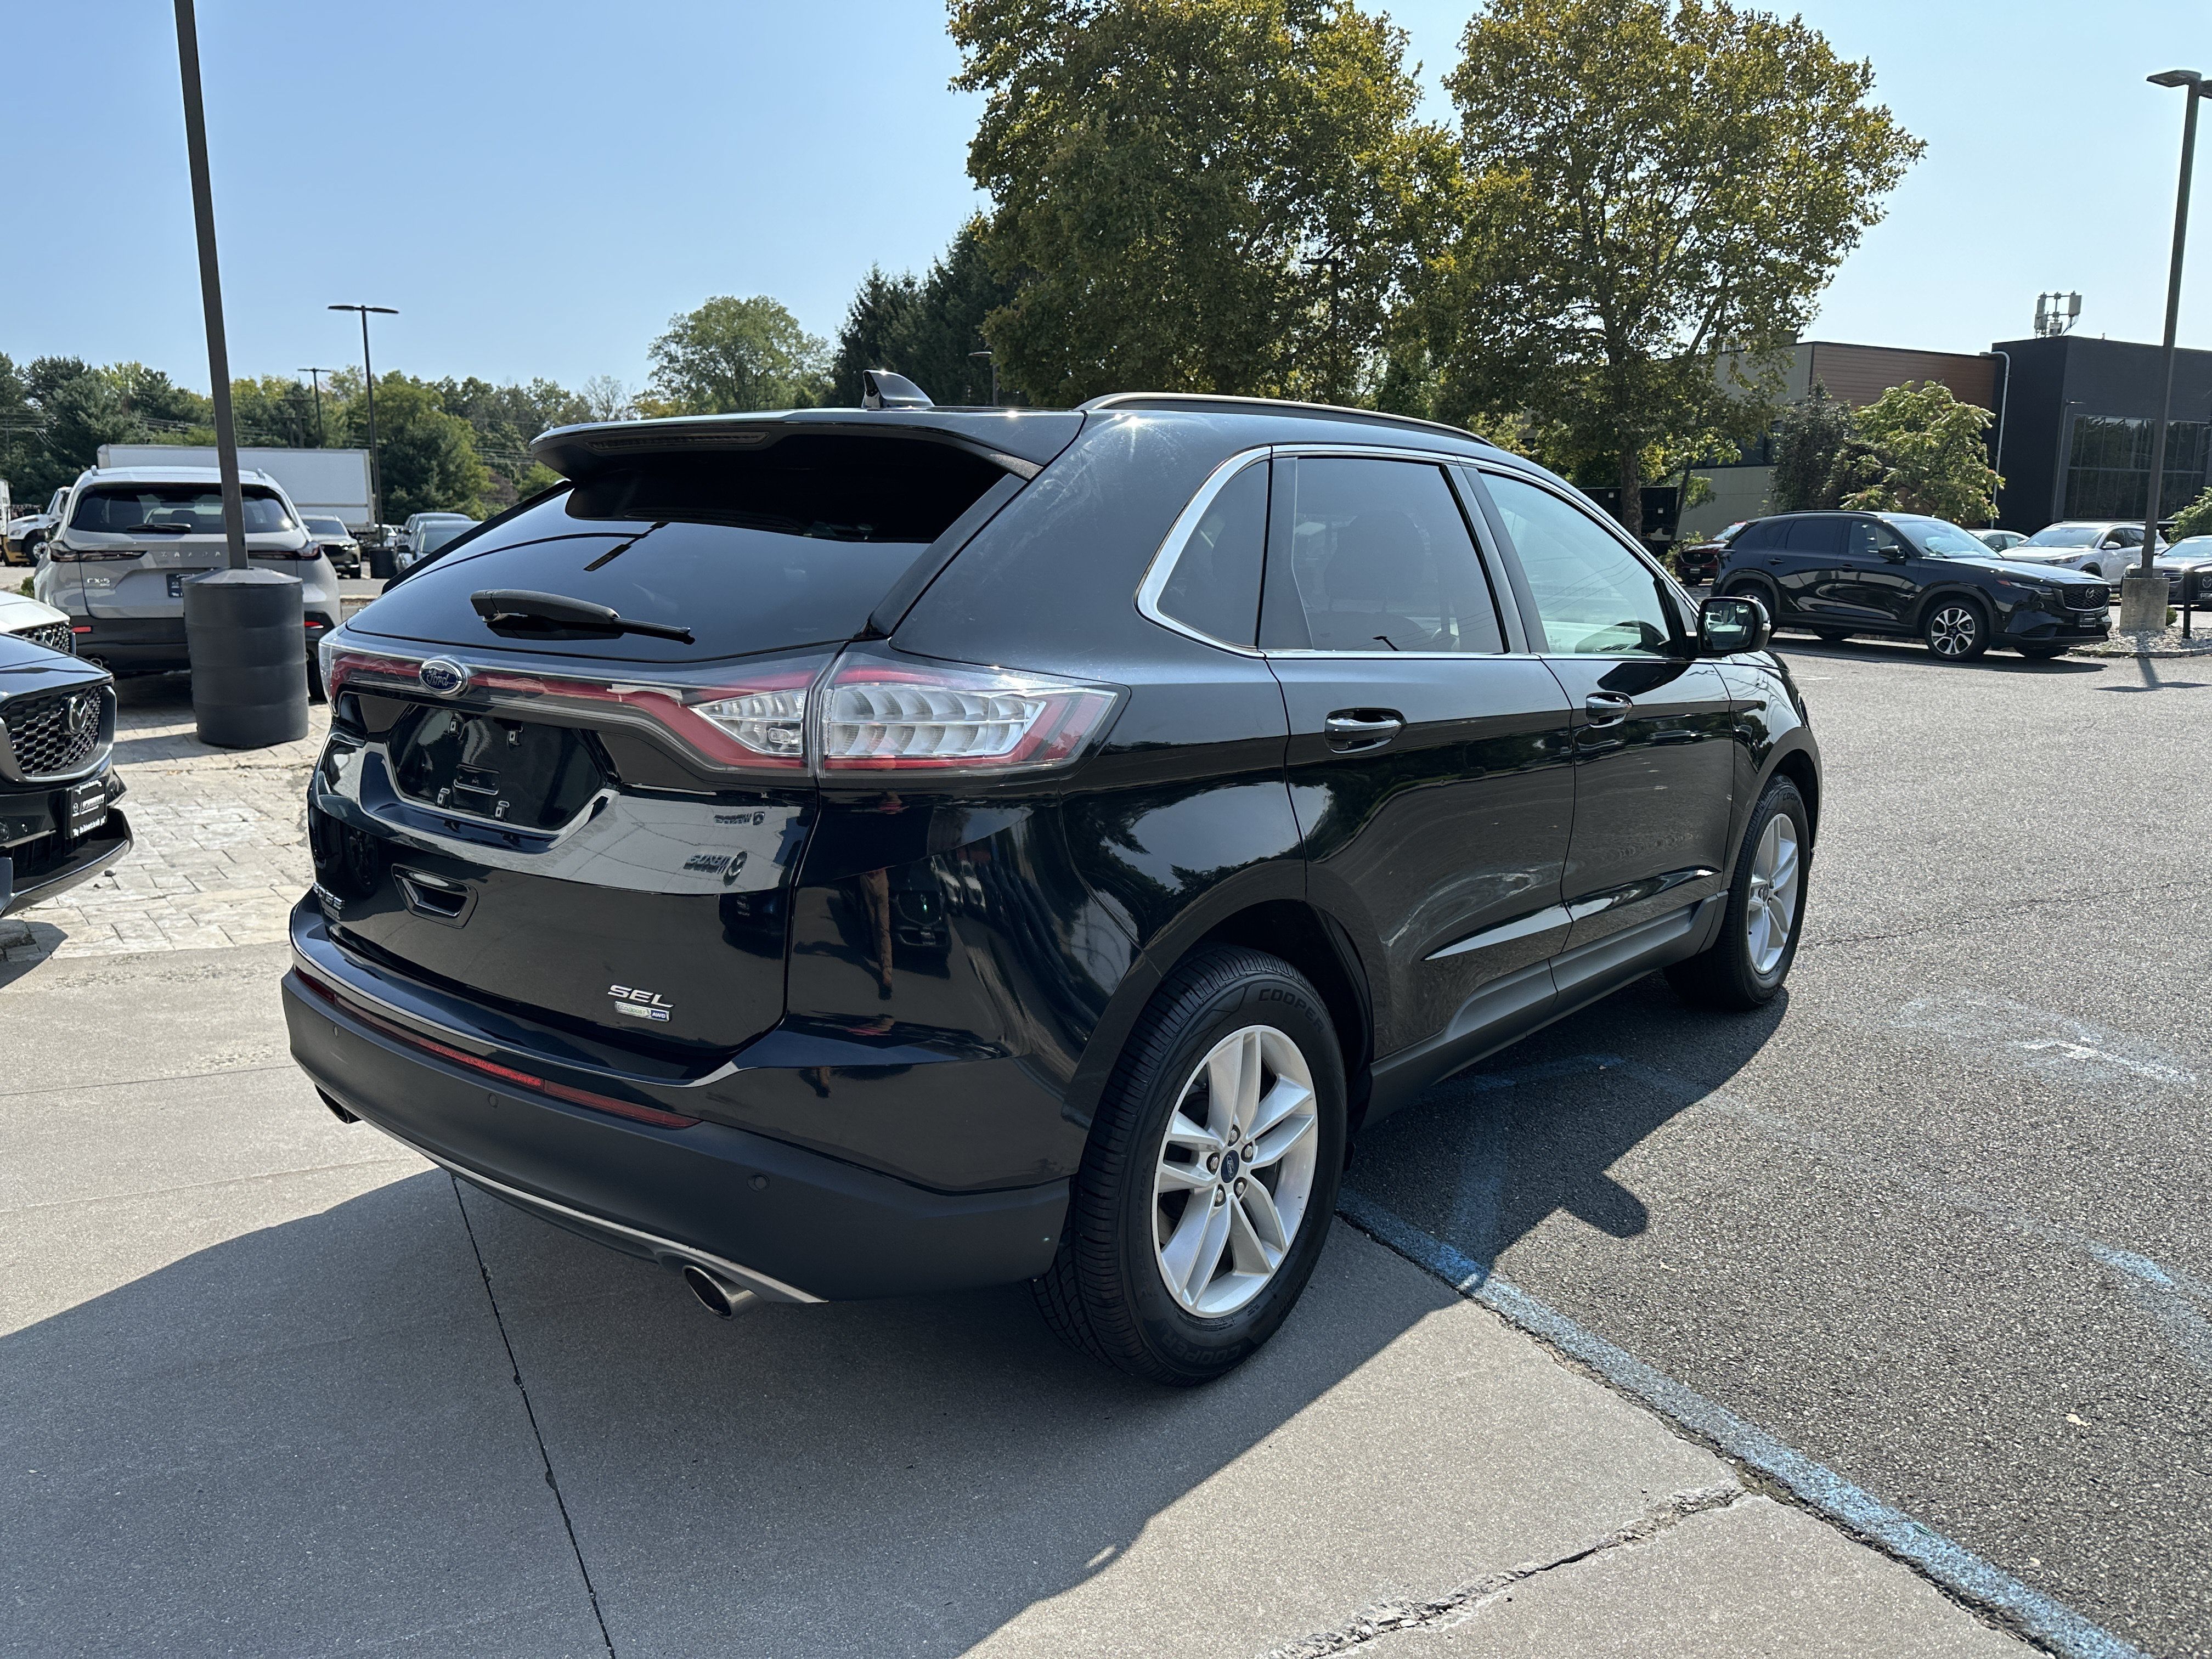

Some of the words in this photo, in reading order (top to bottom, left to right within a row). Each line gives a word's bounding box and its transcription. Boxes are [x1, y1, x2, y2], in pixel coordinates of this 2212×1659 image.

[425, 666, 452, 687] Ford
[312, 881, 343, 910] EDGE
[607, 984, 674, 1008] SEL
[1258, 988, 1325, 1032] COOPER
[1161, 1330, 1241, 1364] COOPER
